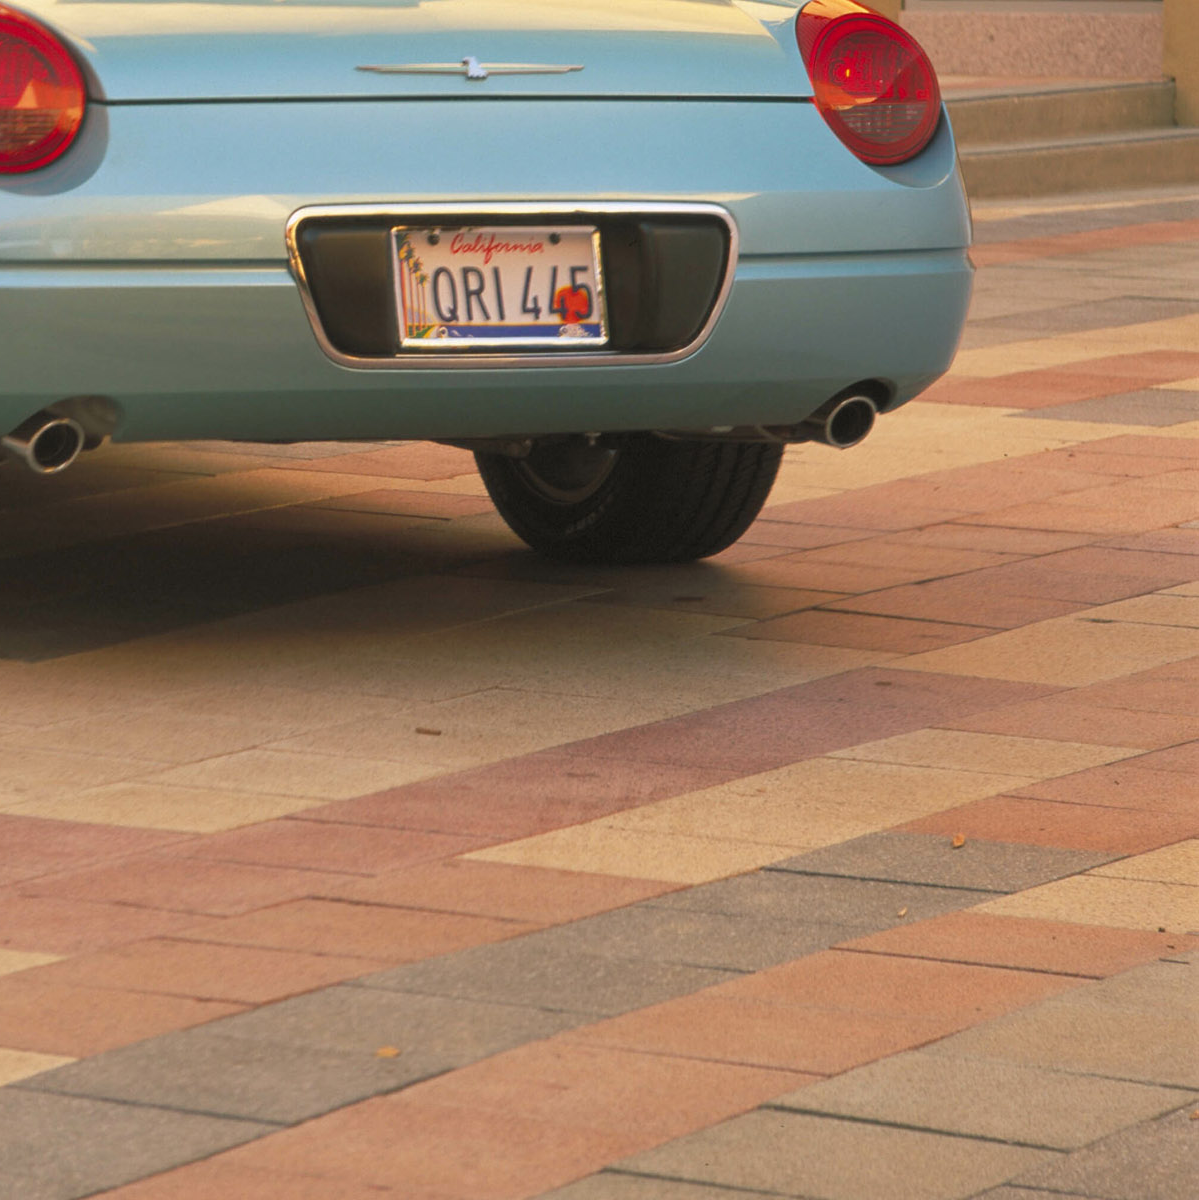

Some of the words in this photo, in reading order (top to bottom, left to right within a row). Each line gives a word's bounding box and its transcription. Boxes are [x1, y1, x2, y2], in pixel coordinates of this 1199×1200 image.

[450, 232, 544, 265] California
[432, 266, 506, 323] QRI
[521, 265, 594, 321] 445
